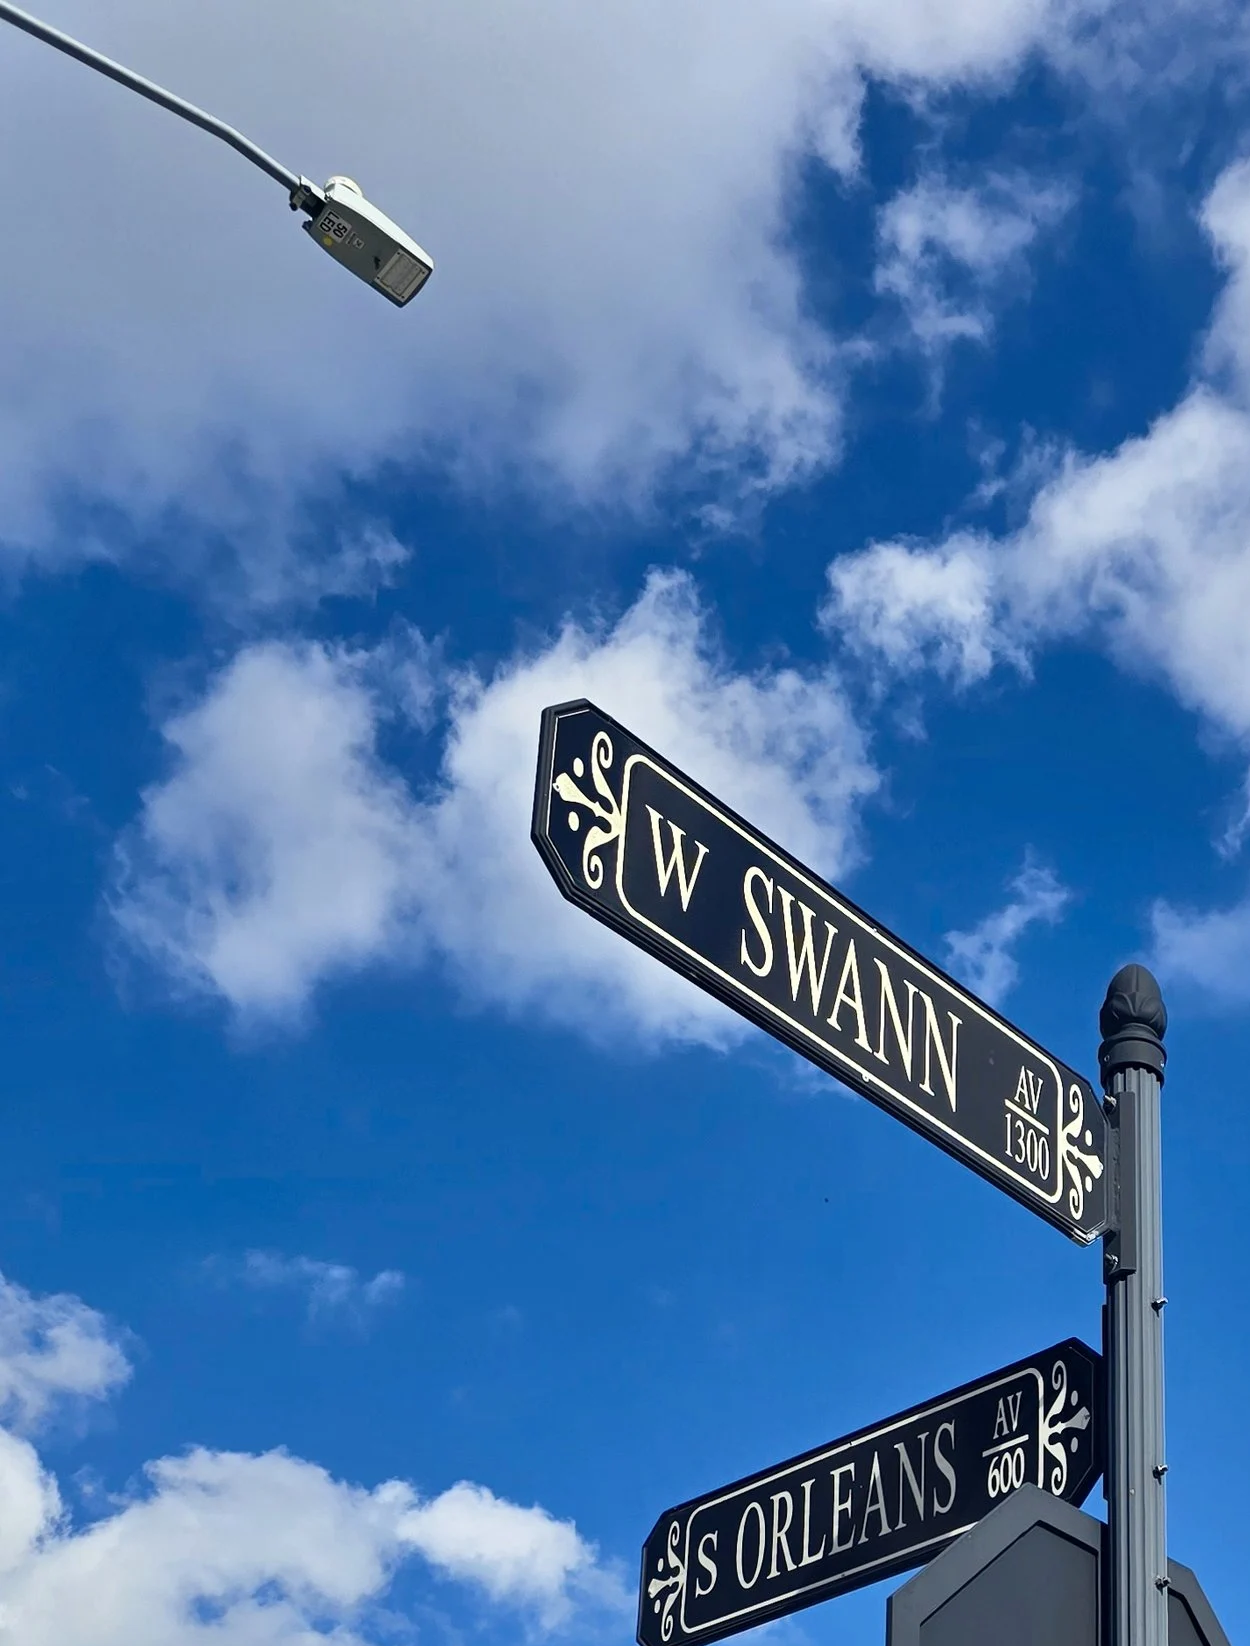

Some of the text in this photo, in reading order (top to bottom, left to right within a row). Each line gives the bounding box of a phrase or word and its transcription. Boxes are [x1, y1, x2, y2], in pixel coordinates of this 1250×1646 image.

[319, 211, 340, 232] LED
[646, 805, 963, 1113] W SWANN
[1014, 1065, 1044, 1115] AV
[1005, 1113, 1050, 1181] 1300
[993, 1391, 1023, 1440] AV
[987, 1447, 1025, 1498] 600
[695, 1419, 957, 1598] S ORLEANS
